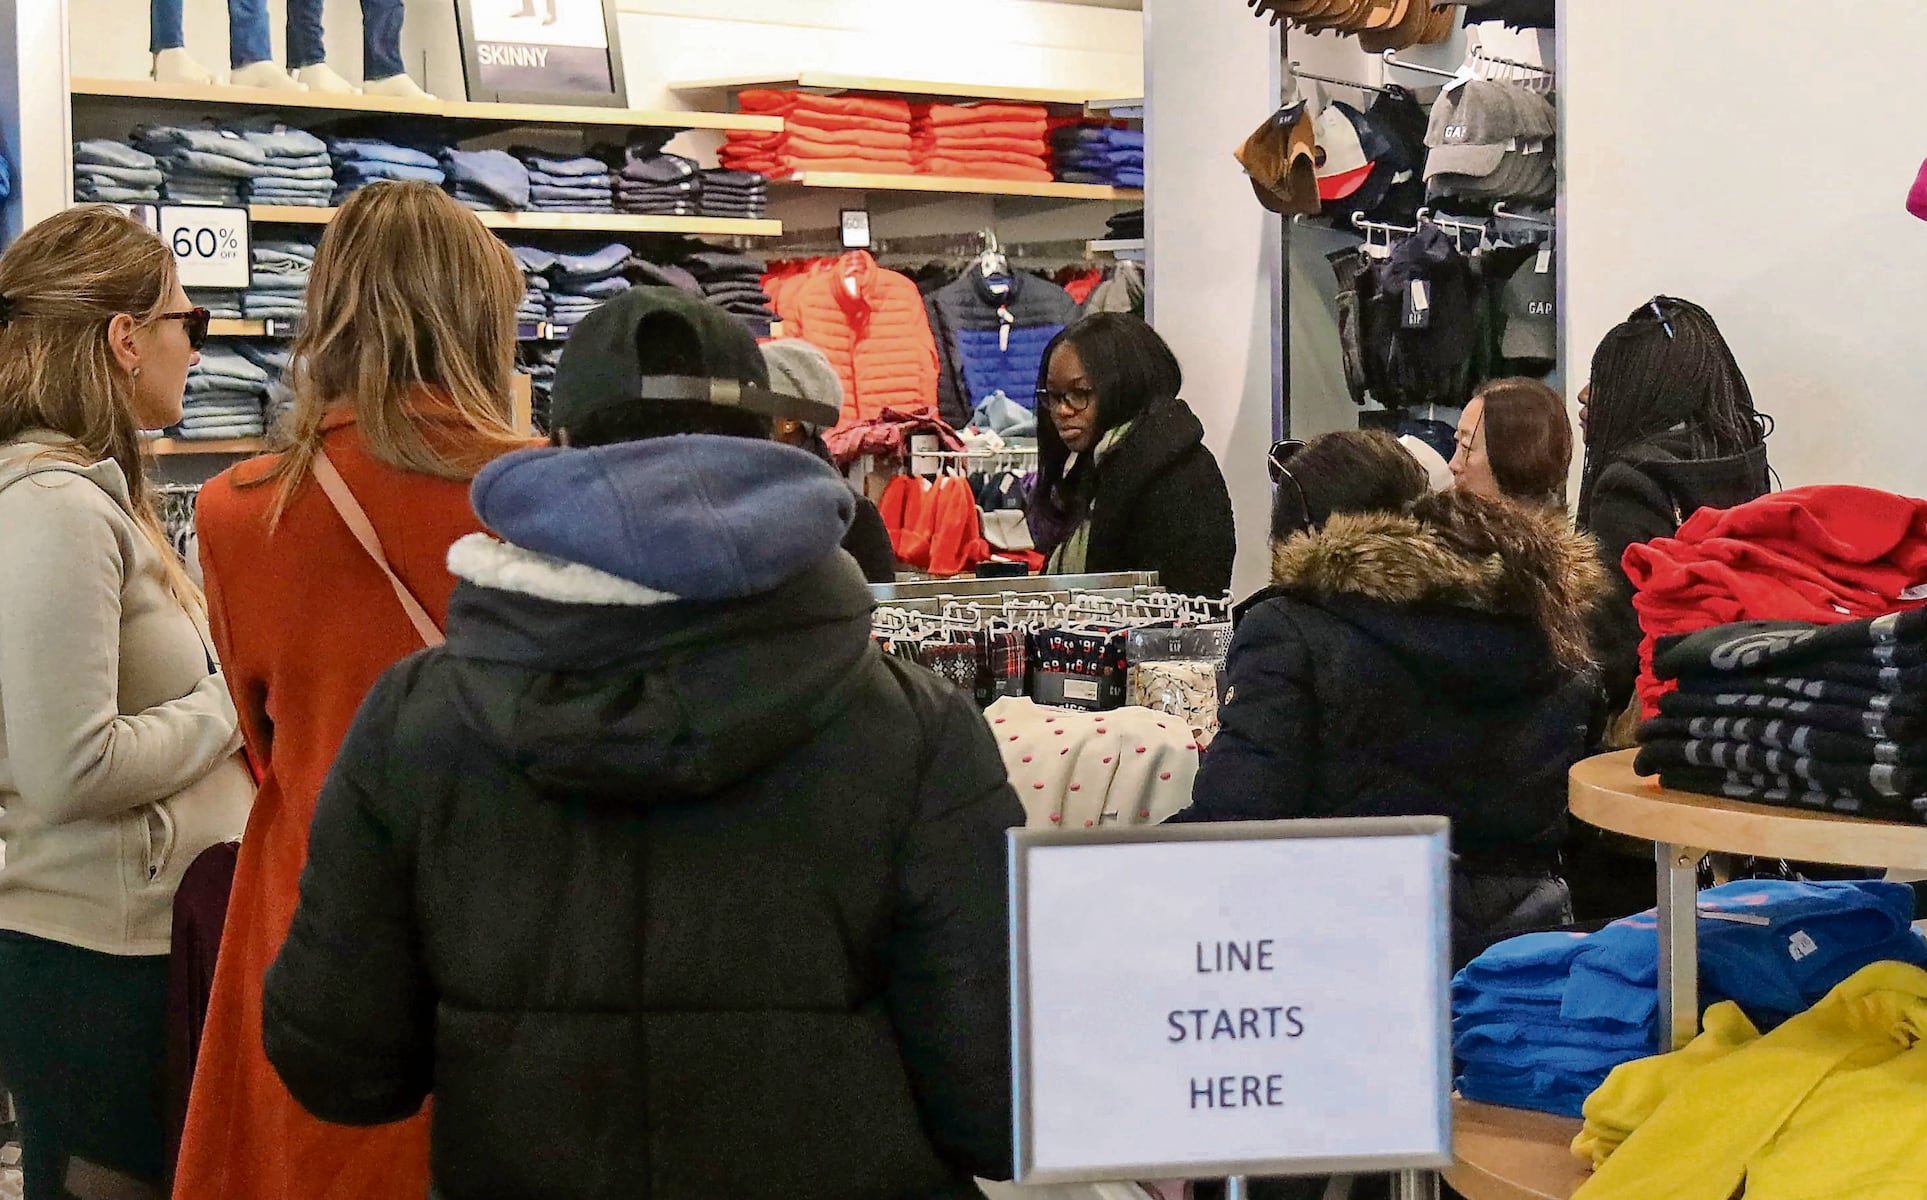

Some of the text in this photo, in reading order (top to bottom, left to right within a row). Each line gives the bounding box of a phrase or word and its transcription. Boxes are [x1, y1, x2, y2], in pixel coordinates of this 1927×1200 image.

[477, 44, 548, 68] SKINNY
[173, 227, 238, 258] 60%
[1529, 301, 1553, 315] GAP
[1196, 939, 1275, 973] LINE
[1167, 1006, 1305, 1043] STARTS
[1190, 1074, 1284, 1109] HERE
